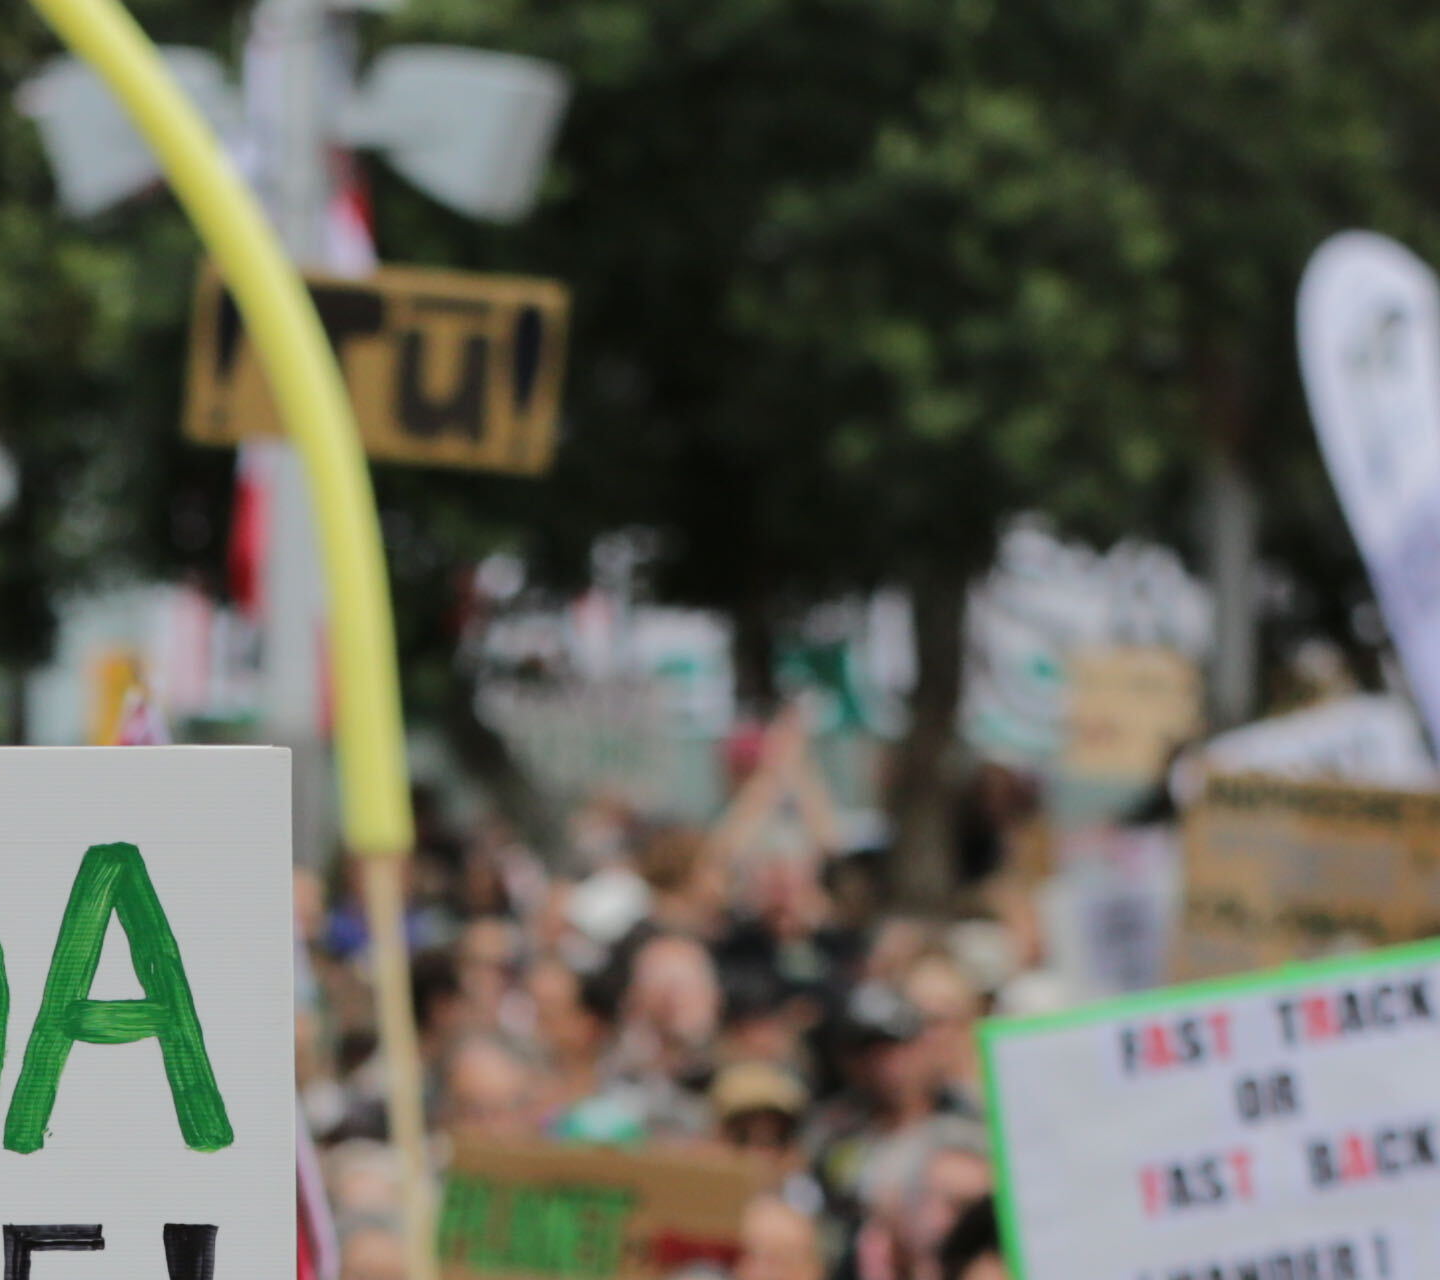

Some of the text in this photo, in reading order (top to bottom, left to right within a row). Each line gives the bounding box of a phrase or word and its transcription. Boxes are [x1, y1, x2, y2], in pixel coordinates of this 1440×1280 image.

[1120, 977, 1438, 1076] FAST TRACK
[1235, 1070, 1302, 1124] OR
[1138, 1147, 1256, 1218] FAST
